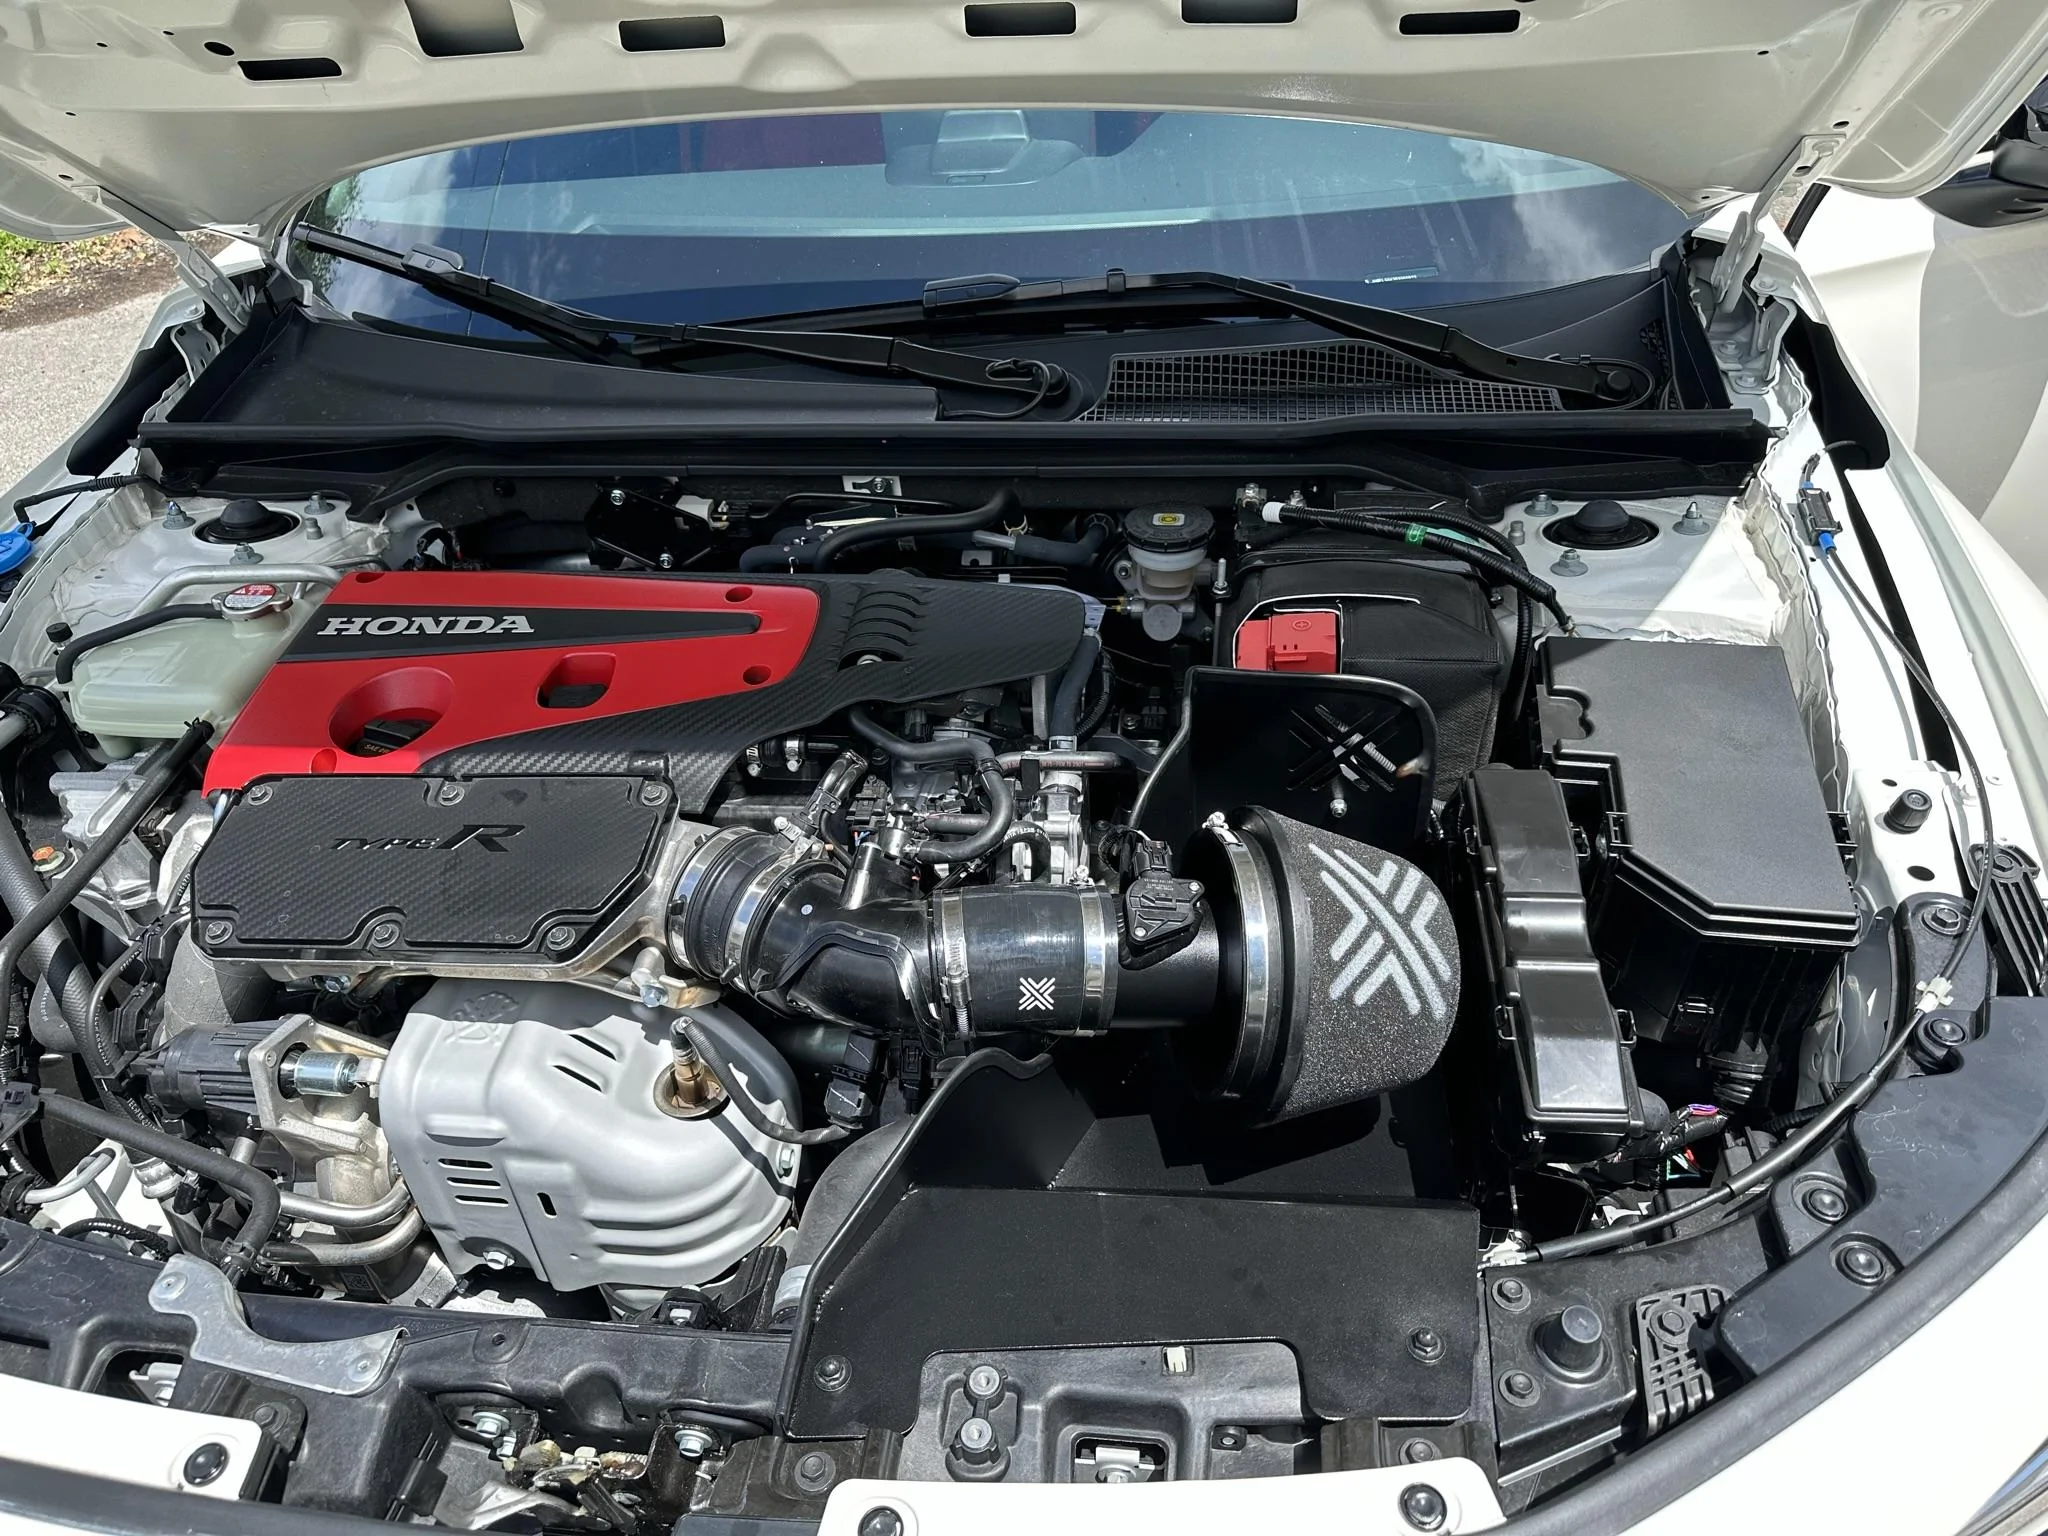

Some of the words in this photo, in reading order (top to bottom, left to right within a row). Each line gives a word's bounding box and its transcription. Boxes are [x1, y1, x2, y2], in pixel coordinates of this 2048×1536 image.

[316, 615, 536, 636] HONDA
[331, 838, 440, 850] TYPE
[434, 824, 526, 852] R
